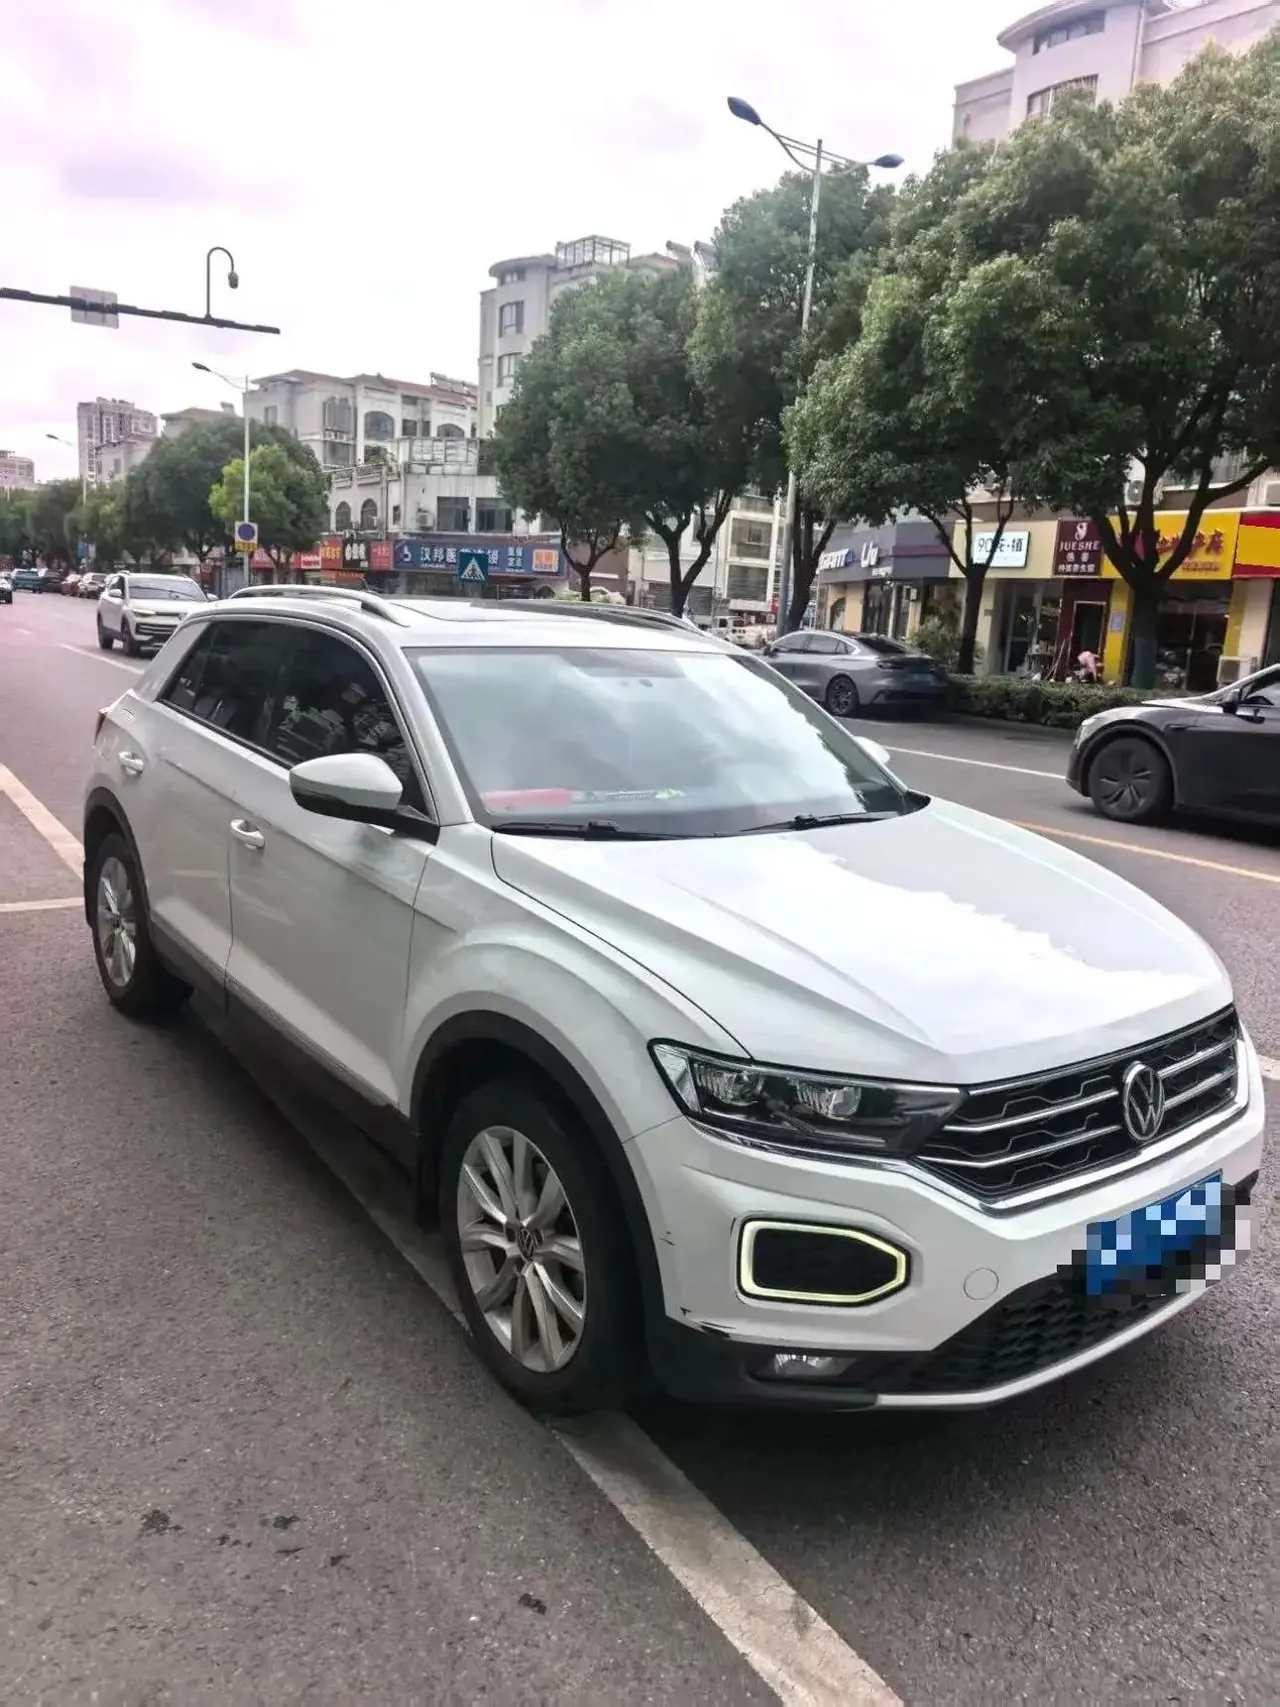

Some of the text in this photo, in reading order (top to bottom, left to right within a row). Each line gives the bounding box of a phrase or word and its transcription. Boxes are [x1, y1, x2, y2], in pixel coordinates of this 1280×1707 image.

[1058, 540, 1100, 552] JUESHE
[420, 546, 500, 565] 汉邦医锁
